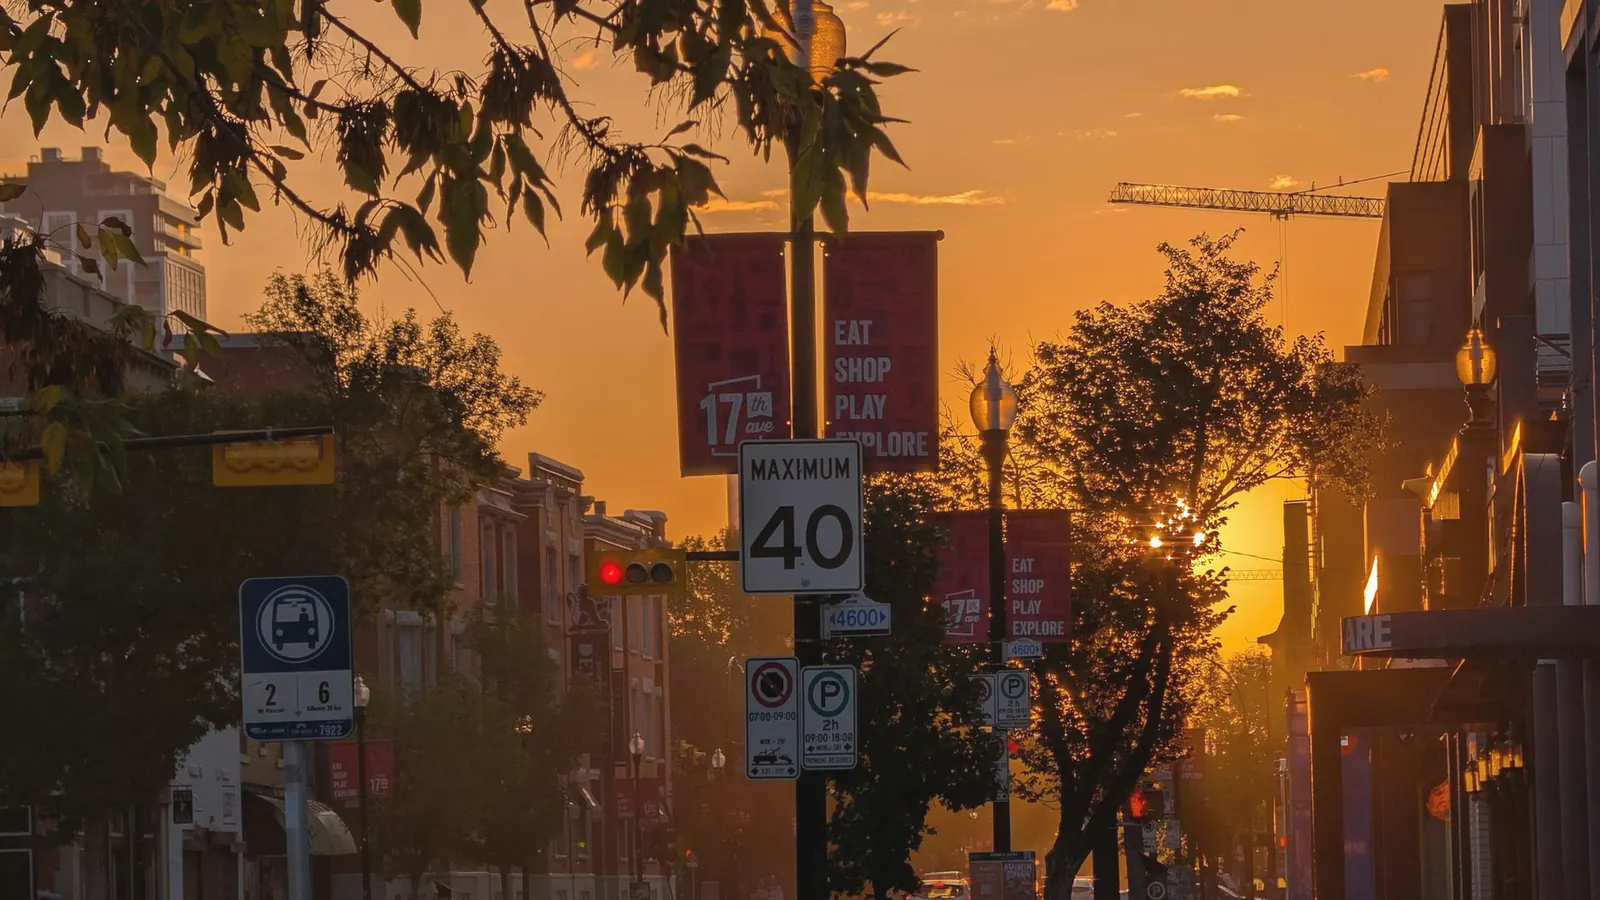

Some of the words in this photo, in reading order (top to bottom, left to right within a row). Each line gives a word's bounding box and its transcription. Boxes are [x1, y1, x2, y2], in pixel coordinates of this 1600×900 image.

[834, 320, 872, 345] EAT
[834, 357, 891, 382] SHOP
[835, 394, 887, 420] PLAY
[745, 420, 774, 434] ave
[752, 458, 850, 480] MAXIMUM
[750, 504, 853, 570] 40
[1012, 558, 1034, 572] EAT
[1012, 580, 1044, 594] SHOP
[1012, 600, 1042, 614] PLAY
[836, 610, 878, 627] 4600
[1012, 621, 1064, 635] EXPLORE
[1344, 615, 1392, 650] ARE
[1012, 644, 1035, 654] 4600
[265, 684, 276, 706] 2
[318, 681, 330, 704] 6
[820, 681, 840, 708] P
[749, 712, 796, 722] 07:00-09:00
[320, 725, 343, 736] 7922
